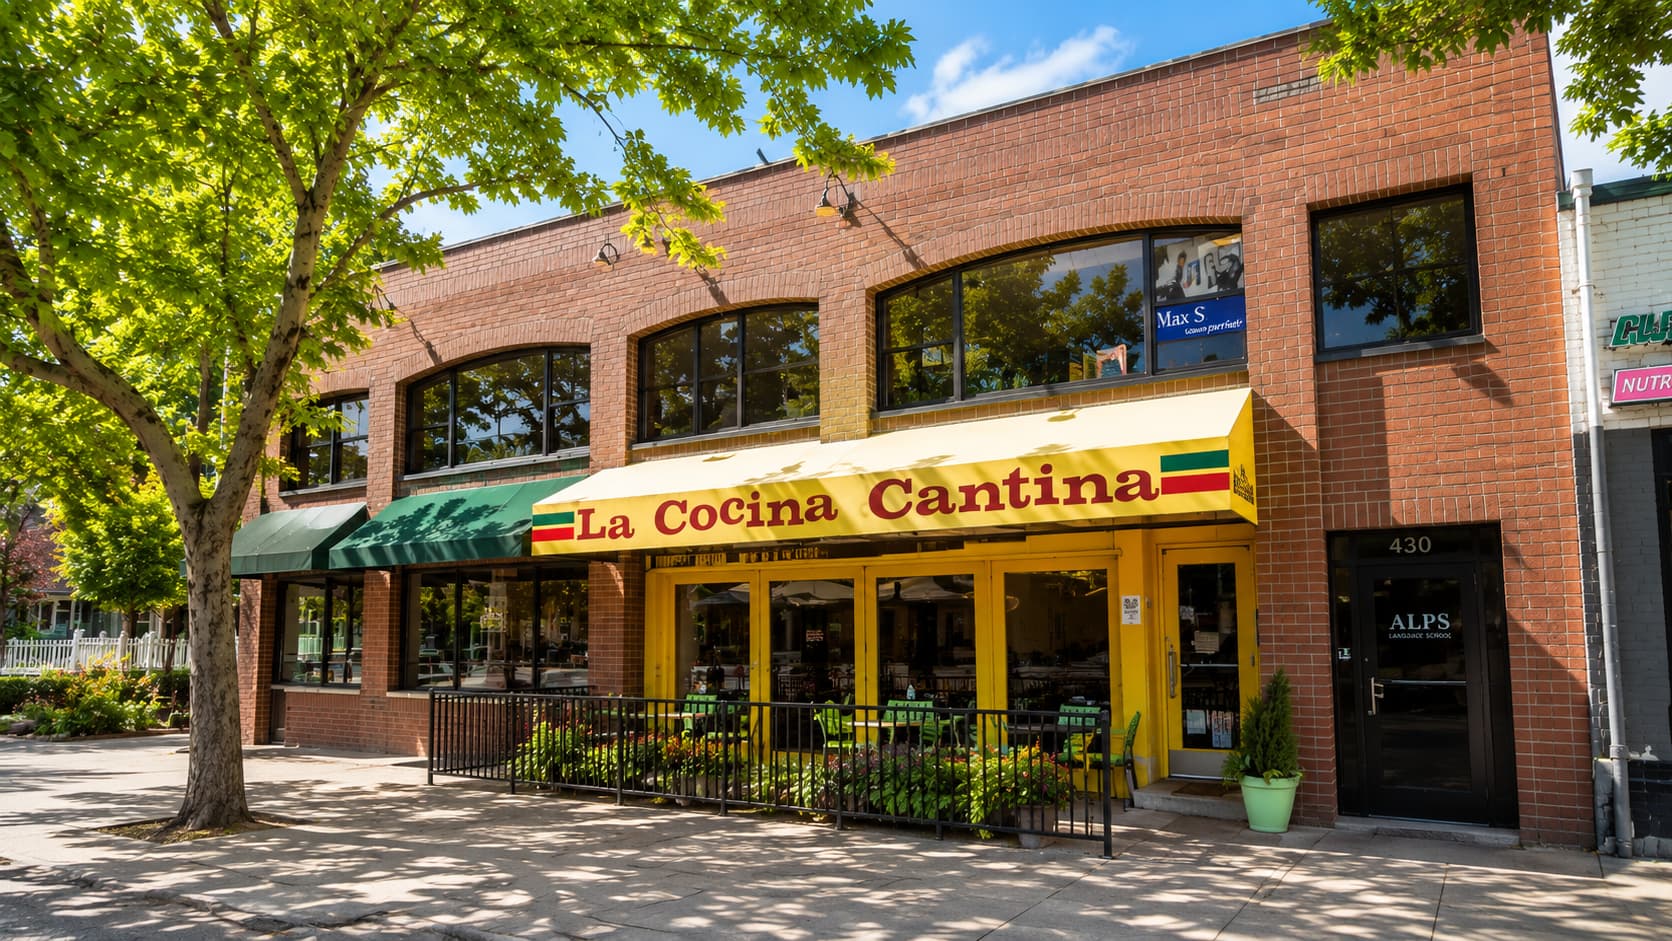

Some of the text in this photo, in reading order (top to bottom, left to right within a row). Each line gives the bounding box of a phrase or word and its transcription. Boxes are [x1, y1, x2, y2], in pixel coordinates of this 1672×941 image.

[1157, 305, 1206, 329] Max S
[1622, 374, 1672, 394] NUTR
[576, 463, 1160, 541] La Cocina Cantina
[1389, 536, 1432, 554] 430
[1388, 613, 1451, 630] ALPS
